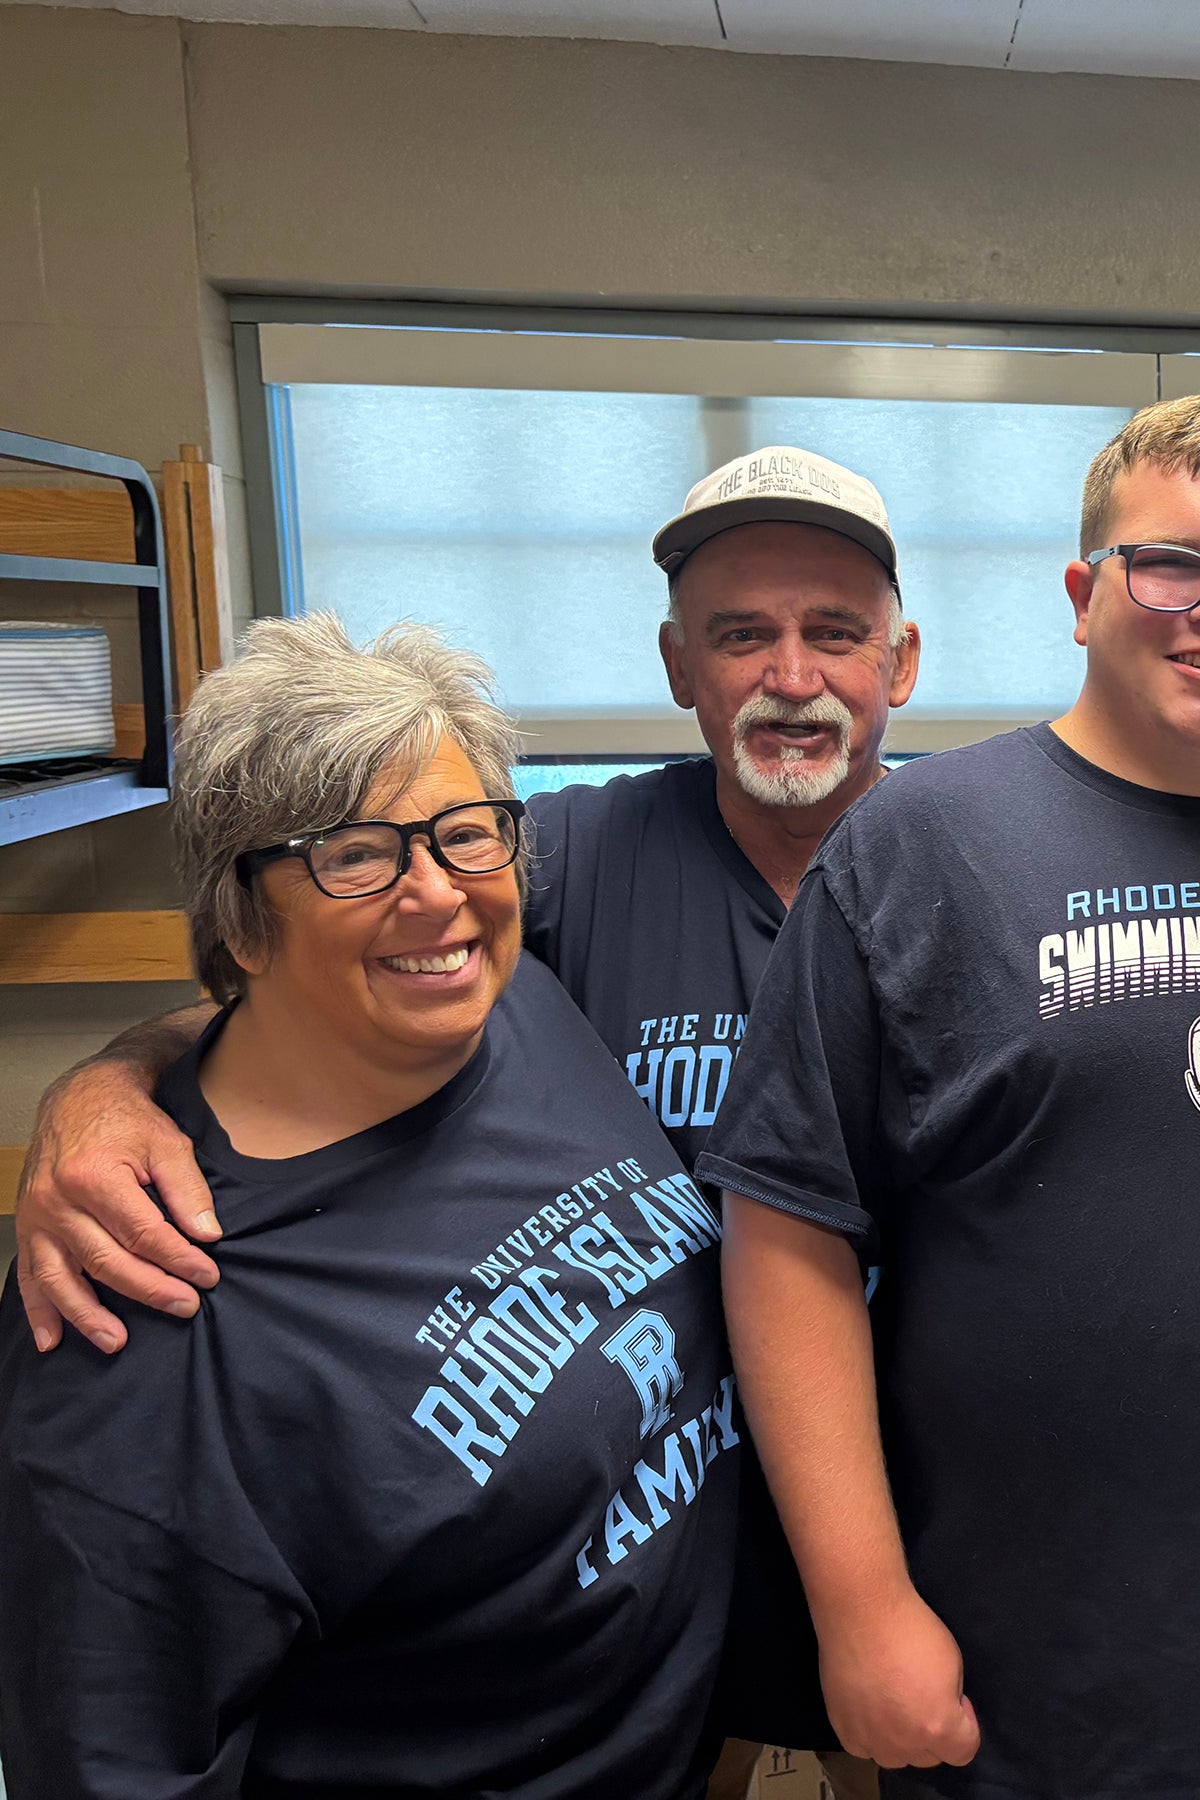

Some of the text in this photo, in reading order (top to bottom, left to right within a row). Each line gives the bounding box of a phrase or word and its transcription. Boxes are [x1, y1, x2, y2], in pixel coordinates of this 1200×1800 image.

[717, 467, 743, 500] THE
[748, 456, 803, 482] BLACK
[1066, 882, 1200, 921] RHODE
[640, 1015, 699, 1046] THE
[415, 1157, 649, 1353] THE UNIVERSITY OF
[411, 1266, 600, 1488] RHODE
